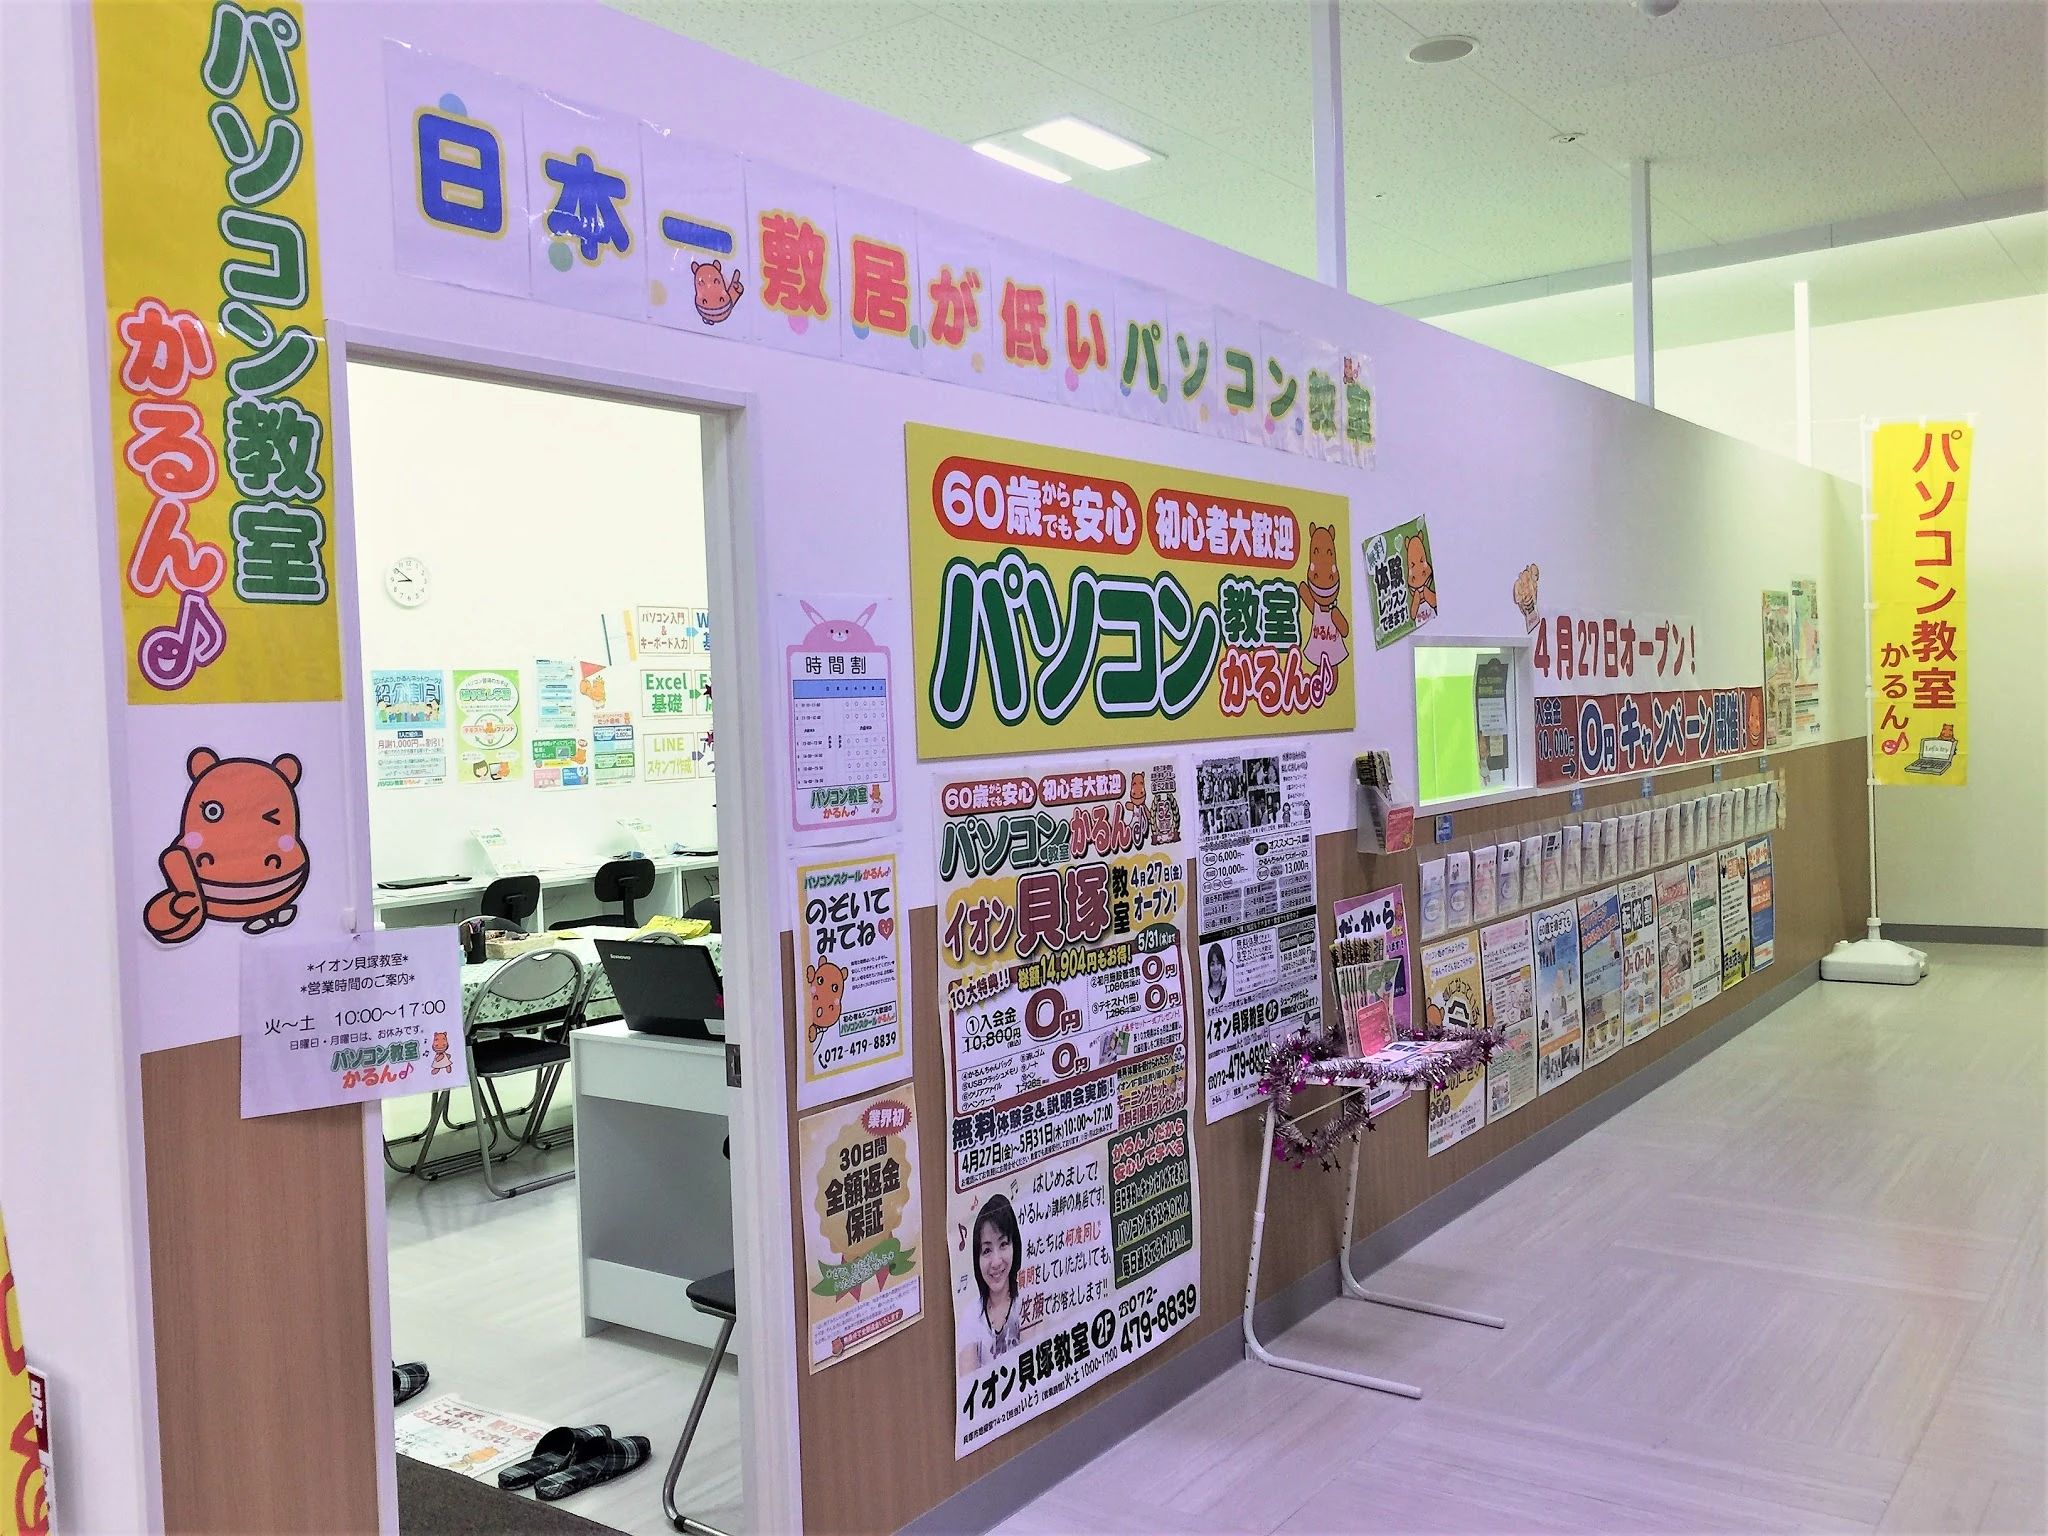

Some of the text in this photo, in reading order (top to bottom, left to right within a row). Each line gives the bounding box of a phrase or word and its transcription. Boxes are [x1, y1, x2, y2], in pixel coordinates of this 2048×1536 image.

[201, 1, 327, 604] パソコン教室
[118, 297, 227, 598] かるん
[1154, 496, 1296, 562] 初心者大歓迎
[1375, 555, 1404, 598] 体験
[1911, 430, 1962, 710] パソコン教室
[642, 611, 685, 625] パソコン入門
[1219, 573, 1301, 651] 教室
[1378, 590, 1407, 616] レッスン
[641, 636, 688, 650] キーボード入力
[661, 625, 667, 636] &
[929, 547, 1221, 729] パソコン
[1534, 615, 1697, 681] 4月27日オープン!
[645, 672, 687, 690] Excel
[805, 656, 867, 675] 時間割
[1218, 644, 1310, 717] かるん
[651, 693, 683, 713] 基礎
[1880, 643, 1910, 730] かるん
[654, 737, 685, 753] LINE
[647, 758, 692, 778] スタンプ作成
[810, 785, 869, 810] パソコン教室
[1042, 773, 1122, 802] 初心者大歓迎
[823, 806, 850, 819] かるん
[1070, 801, 1131, 857] かるん
[940, 812, 1071, 880] パソコン
[804, 866, 885, 890] パソコンスクール かるん
[1130, 862, 1183, 889] 4月27日(金)
[805, 887, 890, 925] のぞいて
[1112, 864, 1131, 936] 教室
[1134, 886, 1178, 922] オープン!
[816, 920, 876, 955] みてね
[334, 999, 446, 1027] 10:00~17:00
[1207, 1002, 1265, 1045] イオン貝塚教室
[289, 1024, 425, 1050] 日曜日・月曜日は、お休みです。
[824, 1030, 897, 1063] 072-479-8839
[330, 1038, 420, 1072] パソコン教室
[342, 1067, 397, 1089] かるん
[868, 1107, 905, 1129] 業界初
[839, 1135, 888, 1172] 30日間
[1113, 1137, 1185, 1185] 安心して学べる
[825, 1157, 901, 1218] 全額返金
[1032, 1160, 1099, 1194] はじめまして!
[845, 1198, 884, 1247] 保証
[1096, 1311, 1113, 1344] 2F
[1120, 1283, 1197, 1355] 479-8839
[962, 1321, 1091, 1421] イオン貝塚教室
